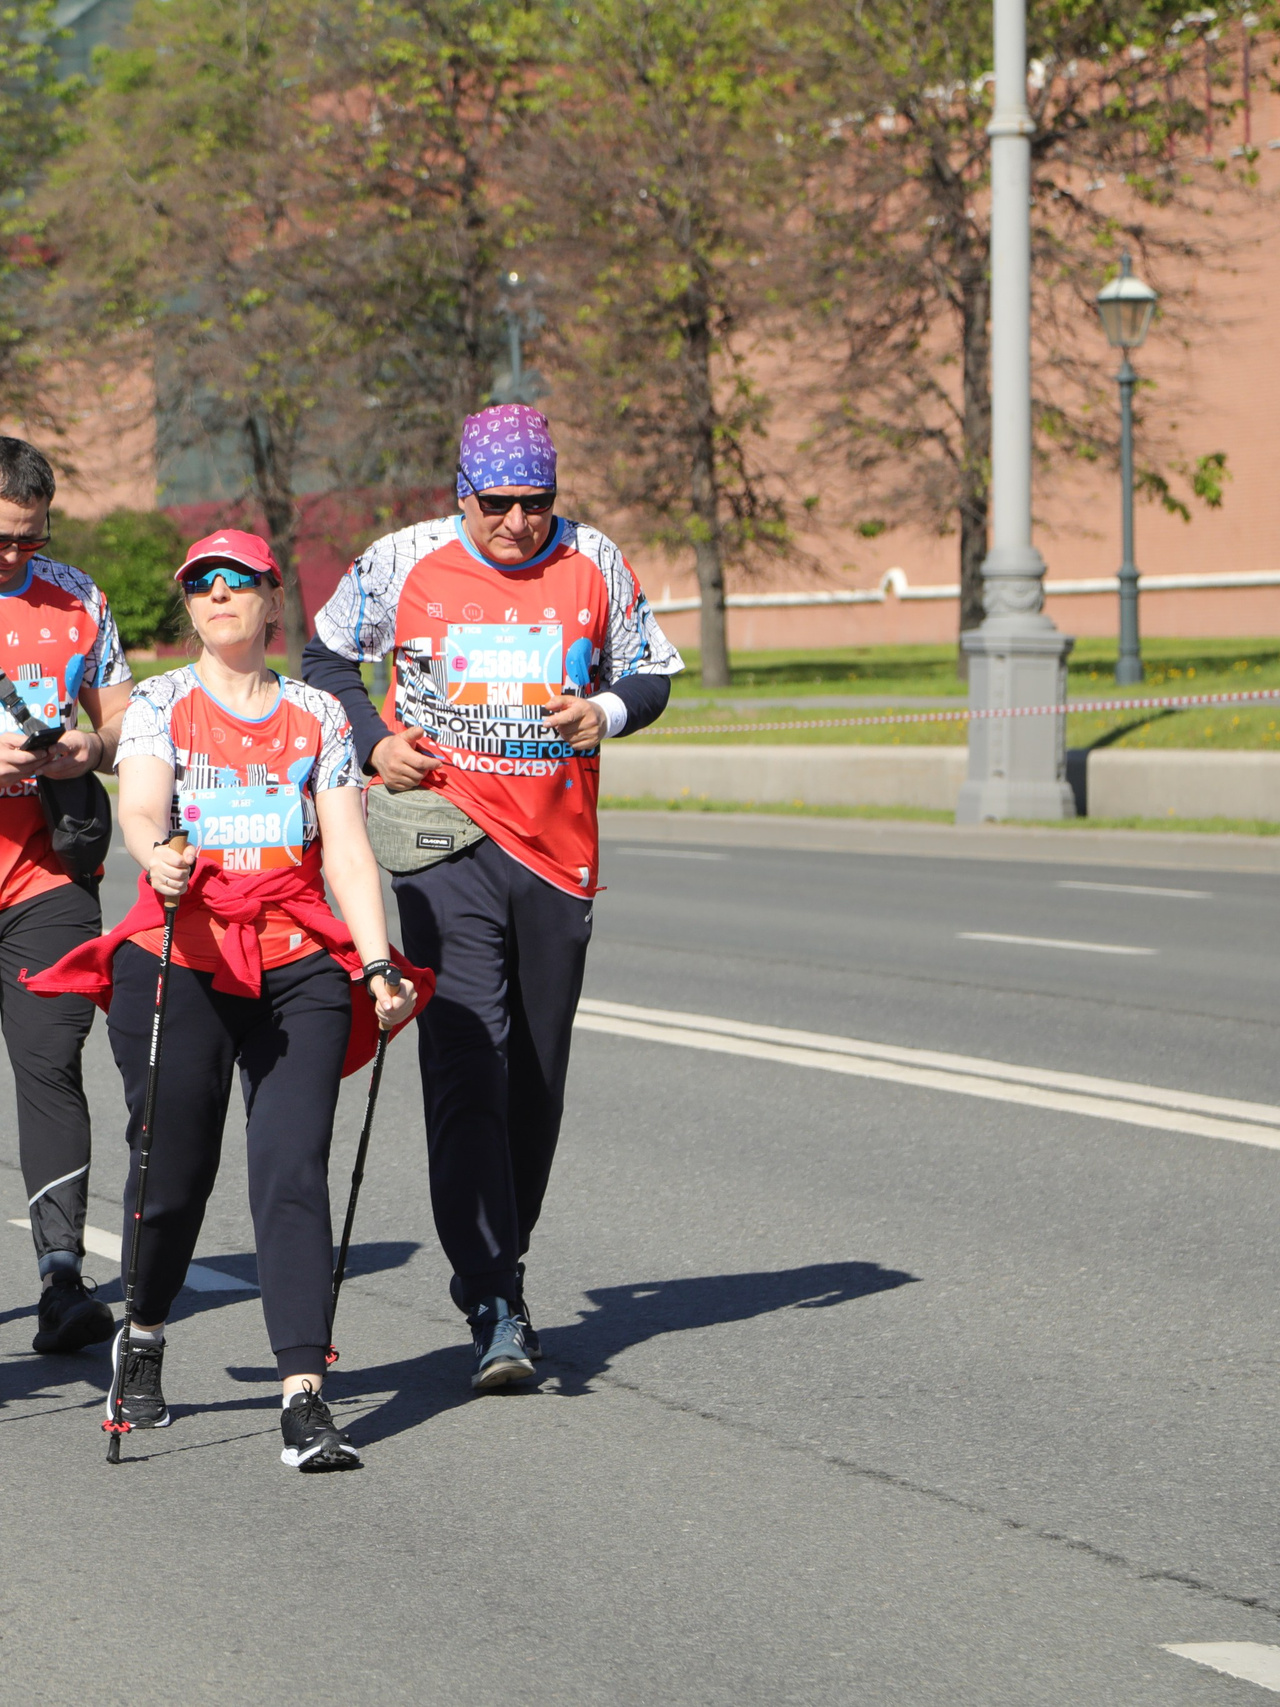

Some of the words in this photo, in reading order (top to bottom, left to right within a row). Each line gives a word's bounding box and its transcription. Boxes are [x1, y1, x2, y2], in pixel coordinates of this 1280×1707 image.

[468, 649, 542, 679] 25864
[487, 682, 523, 706] 5KM
[47, 705, 54, 717] F
[423, 709, 563, 740] ПРОЕКТИРУ
[504, 741, 597, 759] БЕГОВ
[452, 753, 560, 777] МОСКВУ
[188, 807, 197, 819] E
[203, 812, 281, 846] 25868
[223, 847, 261, 870] 5KM
